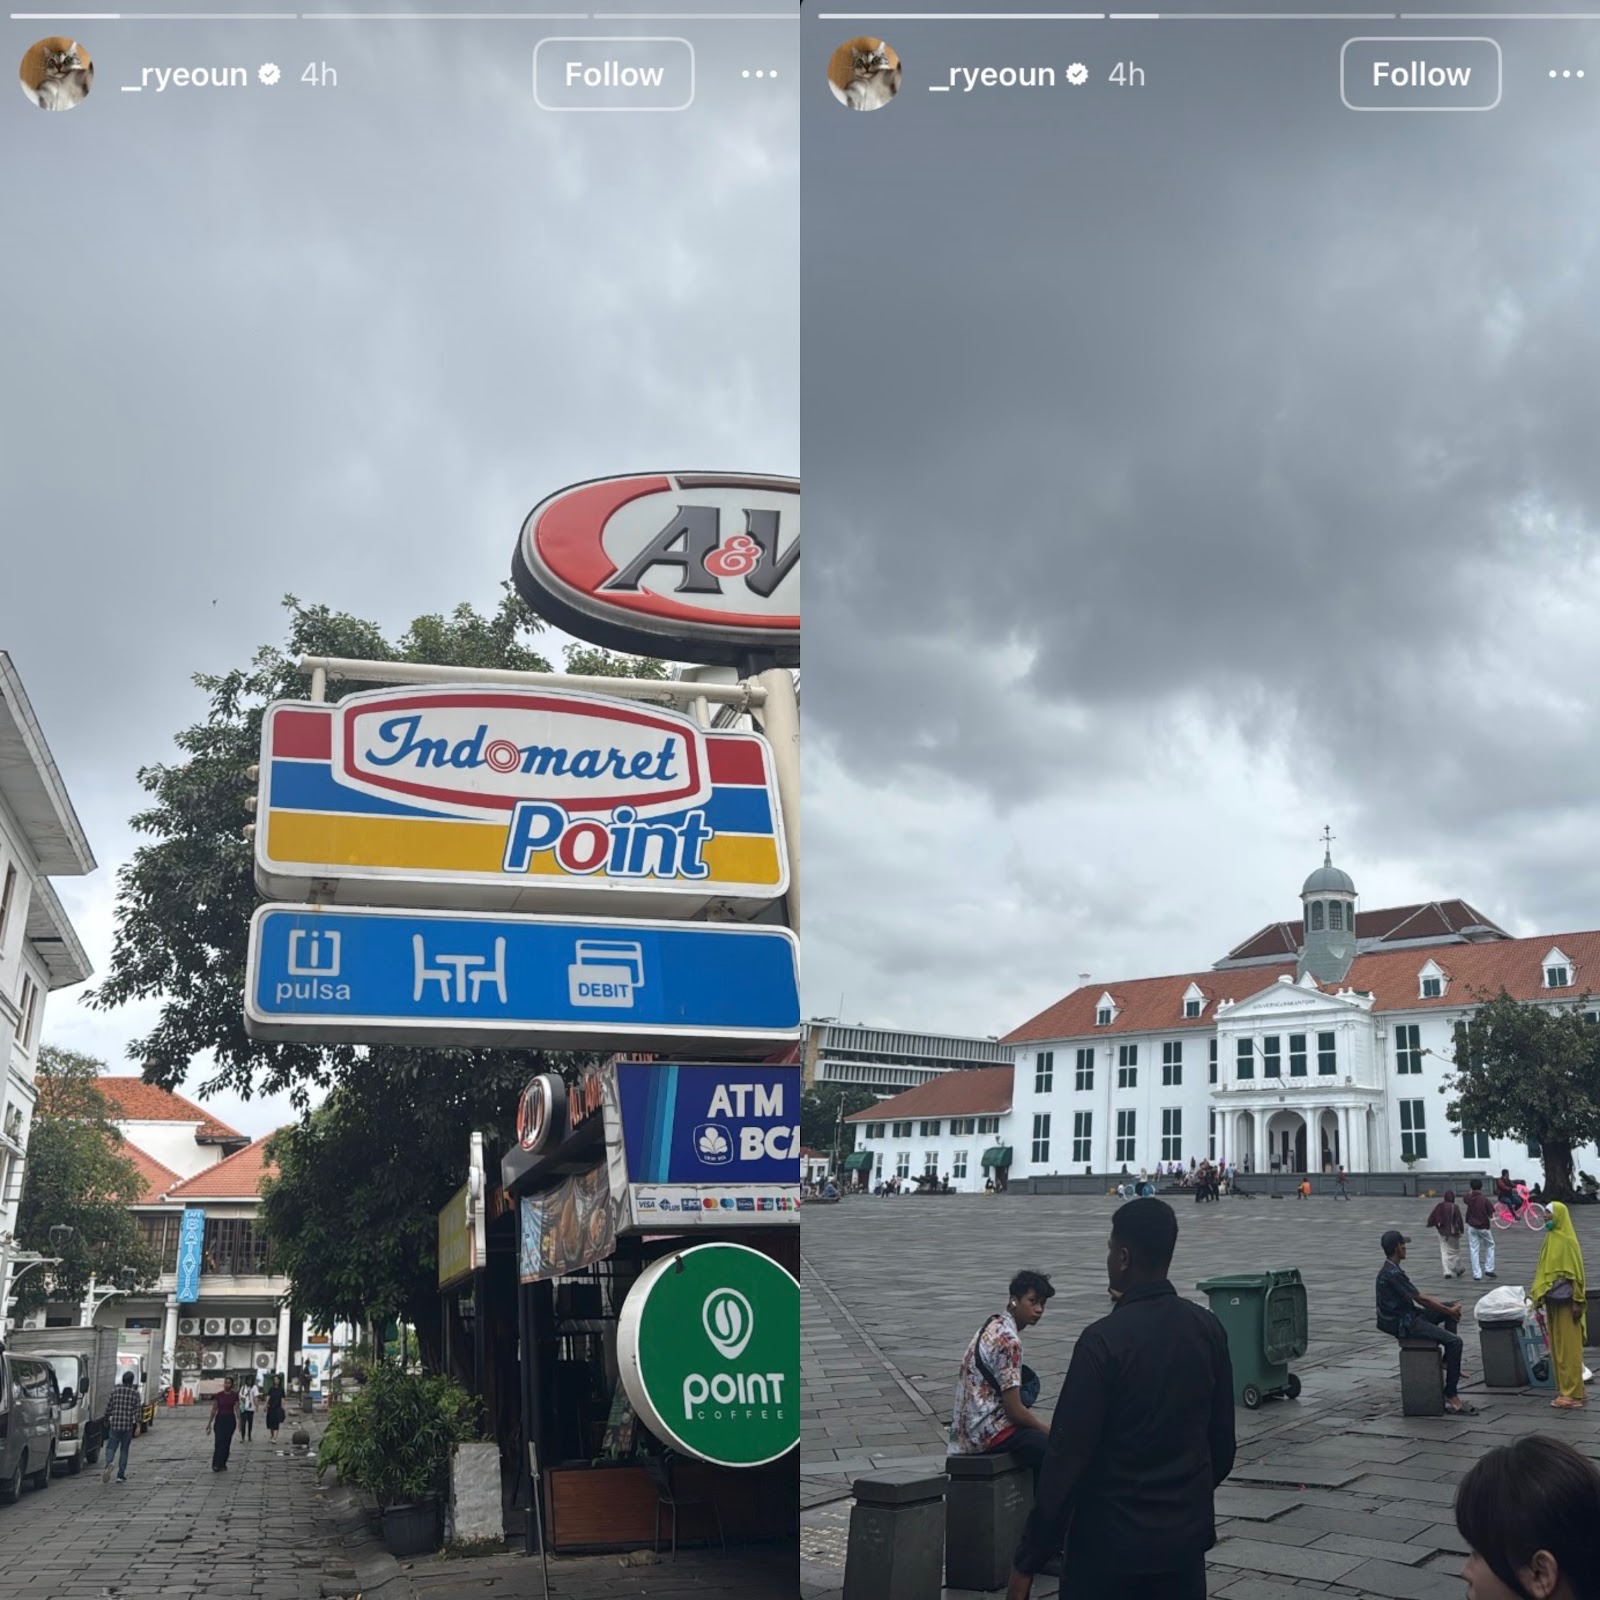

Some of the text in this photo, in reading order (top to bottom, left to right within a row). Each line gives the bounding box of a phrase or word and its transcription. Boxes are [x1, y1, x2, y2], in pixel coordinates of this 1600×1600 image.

[365, 714, 679, 781] Indomaret
[503, 801, 714, 879] Point
[275, 979, 351, 1002] pulsa
[578, 983, 629, 999] DEBIT
[706, 1083, 784, 1118] ATM
[638, 1201, 656, 1209] VISA
[664, 1204, 681, 1212] PLUS
[179, 1219, 199, 1299] BATAVIA
[697, 1409, 784, 1420] COFFEE
